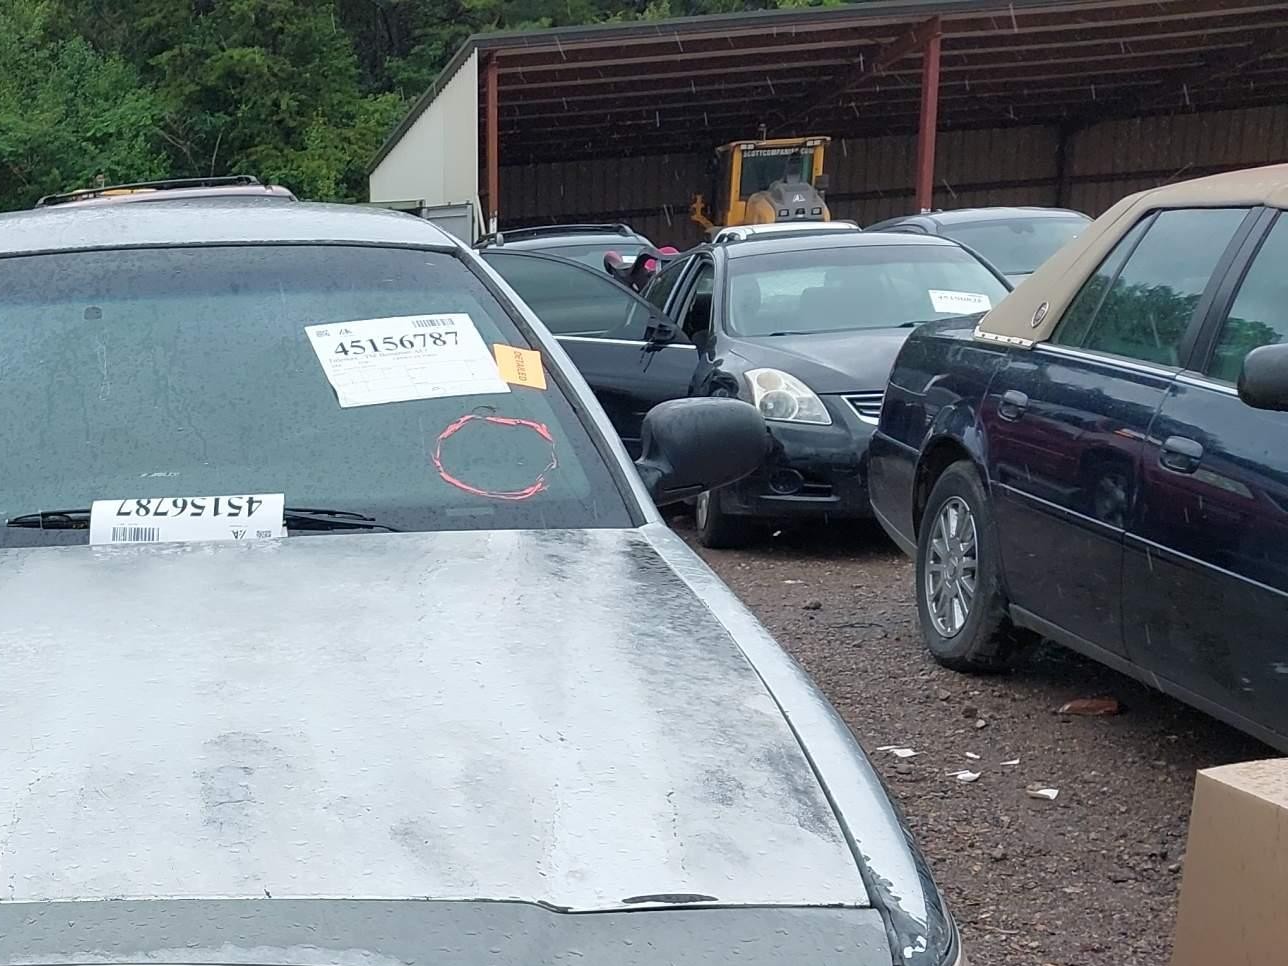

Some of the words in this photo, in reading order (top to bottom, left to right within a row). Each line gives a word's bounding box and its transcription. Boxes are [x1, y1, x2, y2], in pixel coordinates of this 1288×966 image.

[334, 331, 460, 356] 45156787
[514, 351, 527, 382] DETAILED
[116, 496, 263, 518] 45156787
